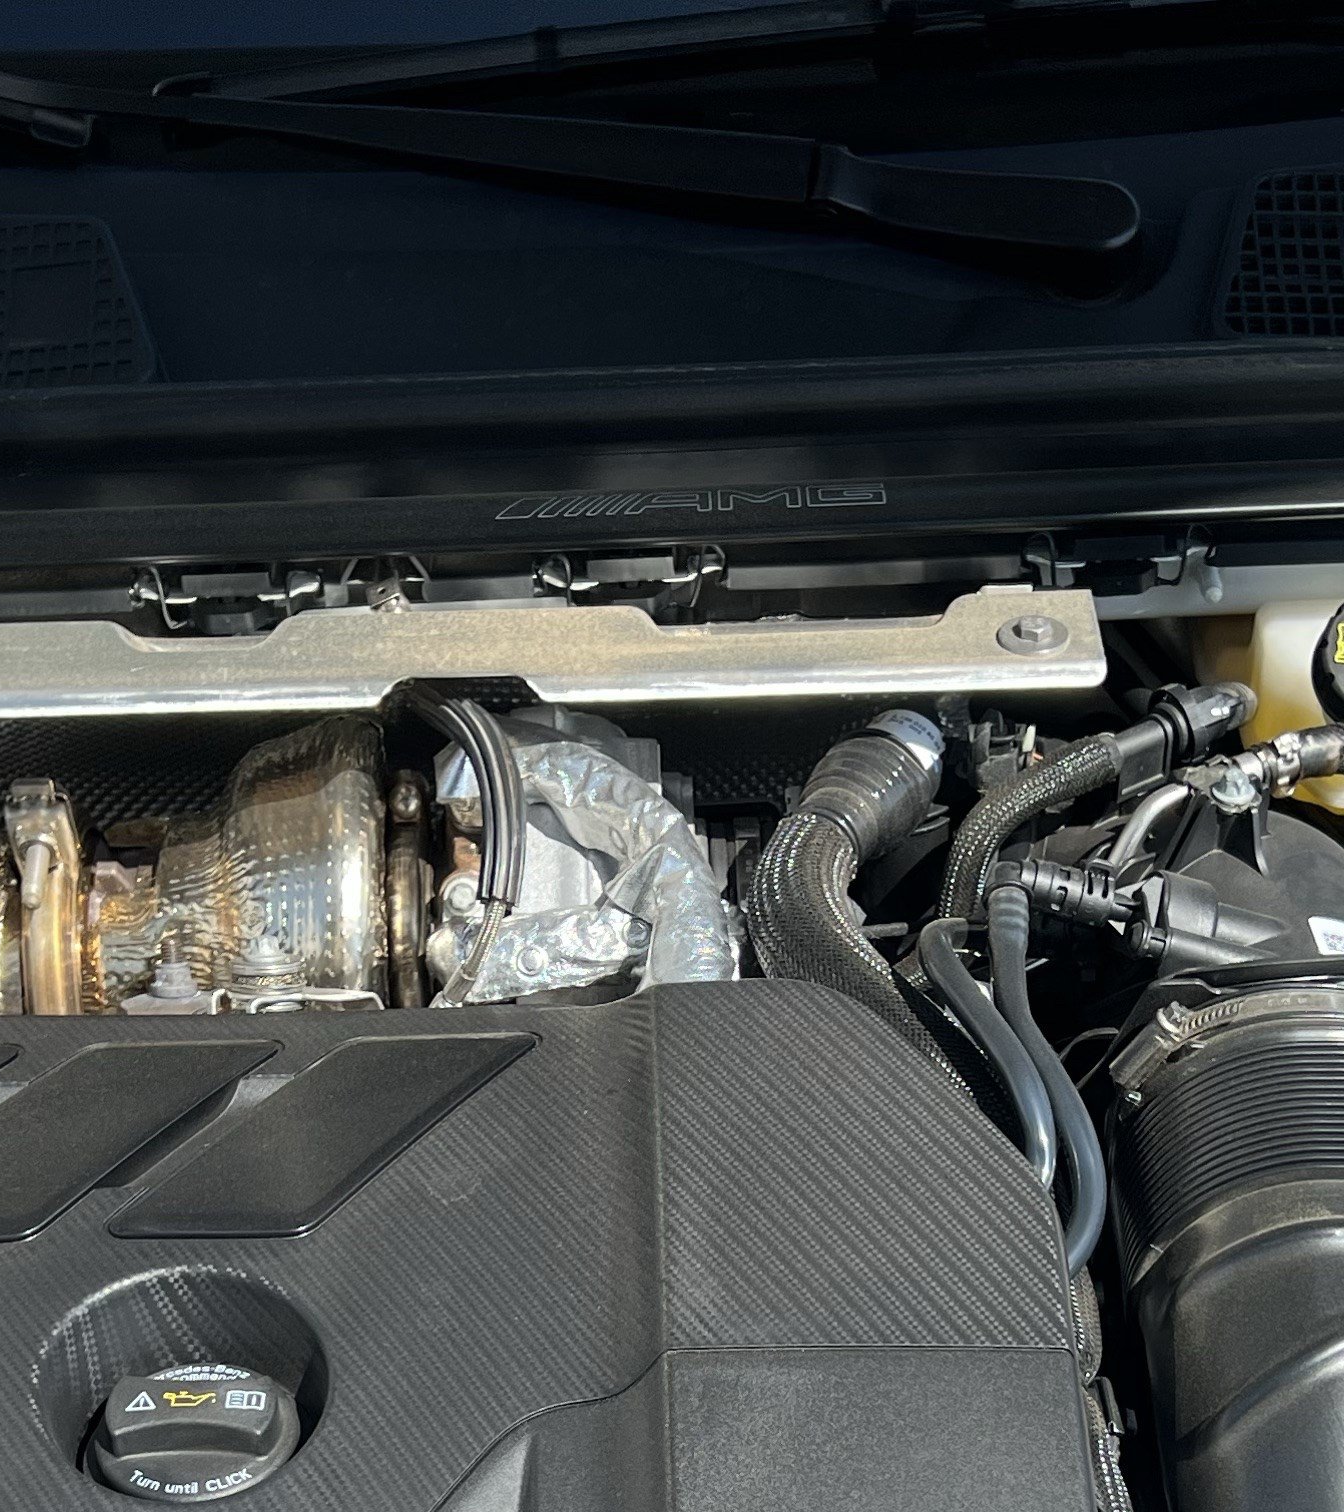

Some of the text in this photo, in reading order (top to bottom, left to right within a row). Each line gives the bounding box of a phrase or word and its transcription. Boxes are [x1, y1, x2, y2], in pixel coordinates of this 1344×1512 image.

[624, 483, 887, 515] AMG
[129, 1468, 253, 1494] Turn until CLICK
